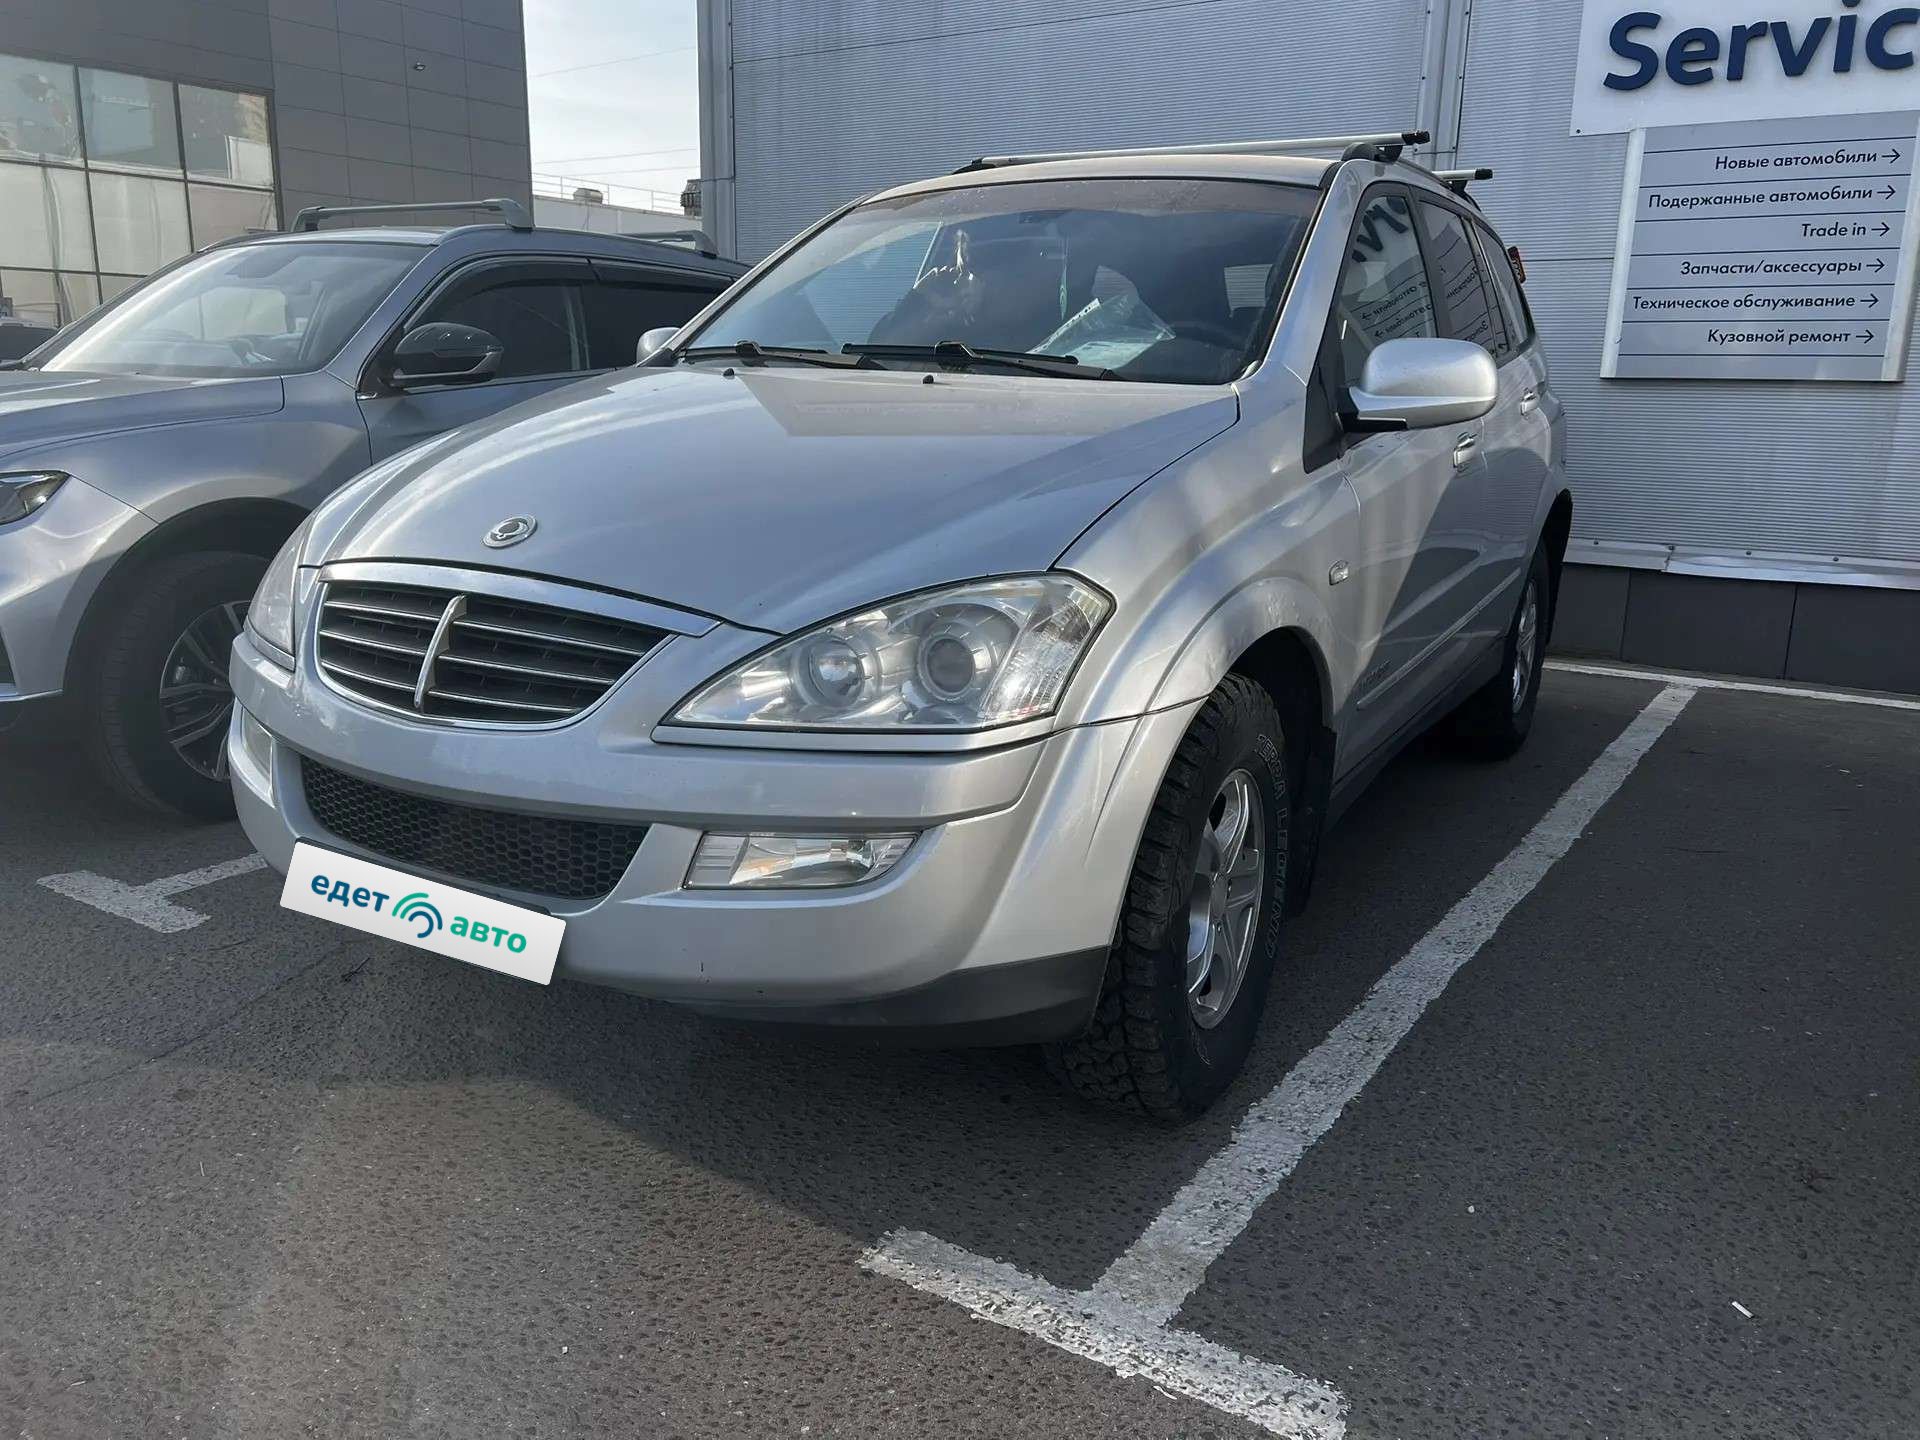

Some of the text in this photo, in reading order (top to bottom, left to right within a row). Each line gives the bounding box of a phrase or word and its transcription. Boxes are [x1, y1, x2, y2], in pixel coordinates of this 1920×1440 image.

[1602, 0, 1920, 91] Servic
[1714, 149, 1877, 171] Новые автомобили
[1648, 185, 1873, 210] Подержанные автомобили
[1801, 222, 1867, 237] Trade in
[1680, 259, 1862, 276] Запчасти/аксессуары
[1632, 293, 1856, 310] Техническое обслуживание
[1707, 329, 1851, 346] Кузовной ремонт
